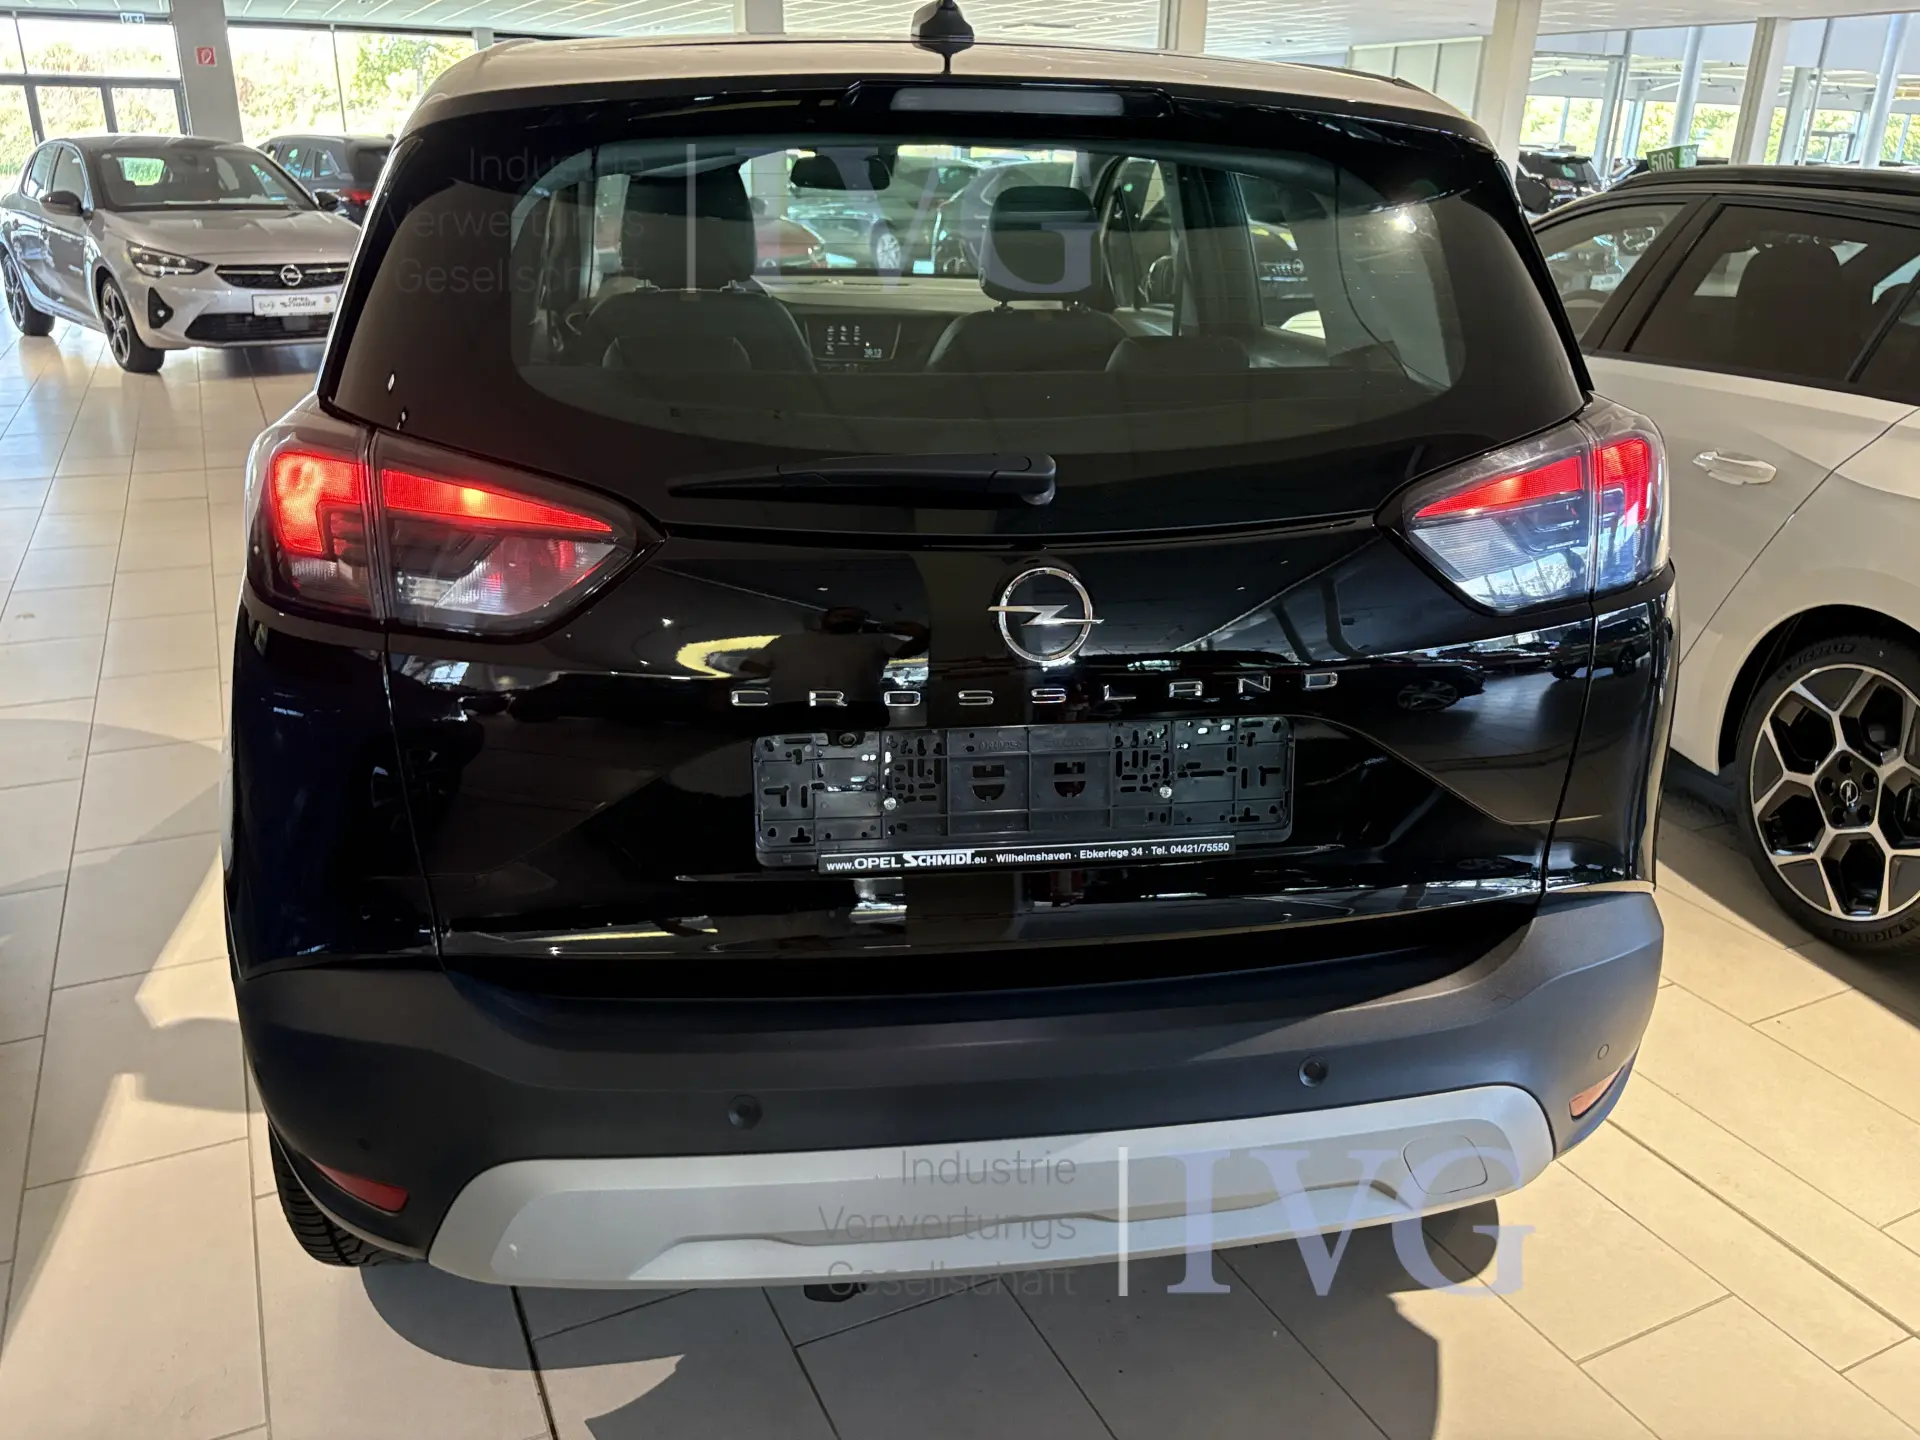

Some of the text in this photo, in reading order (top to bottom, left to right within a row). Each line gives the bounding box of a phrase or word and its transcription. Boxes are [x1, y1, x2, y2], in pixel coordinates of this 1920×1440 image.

[731, 671, 1338, 707] CROSSLAND
[996, 852, 1071, 864] Wilhelmshaven
[1131, 847, 1143, 856] 34
[1151, 846, 1168, 855] Tel.
[1170, 843, 1230, 854] 04421/75550
